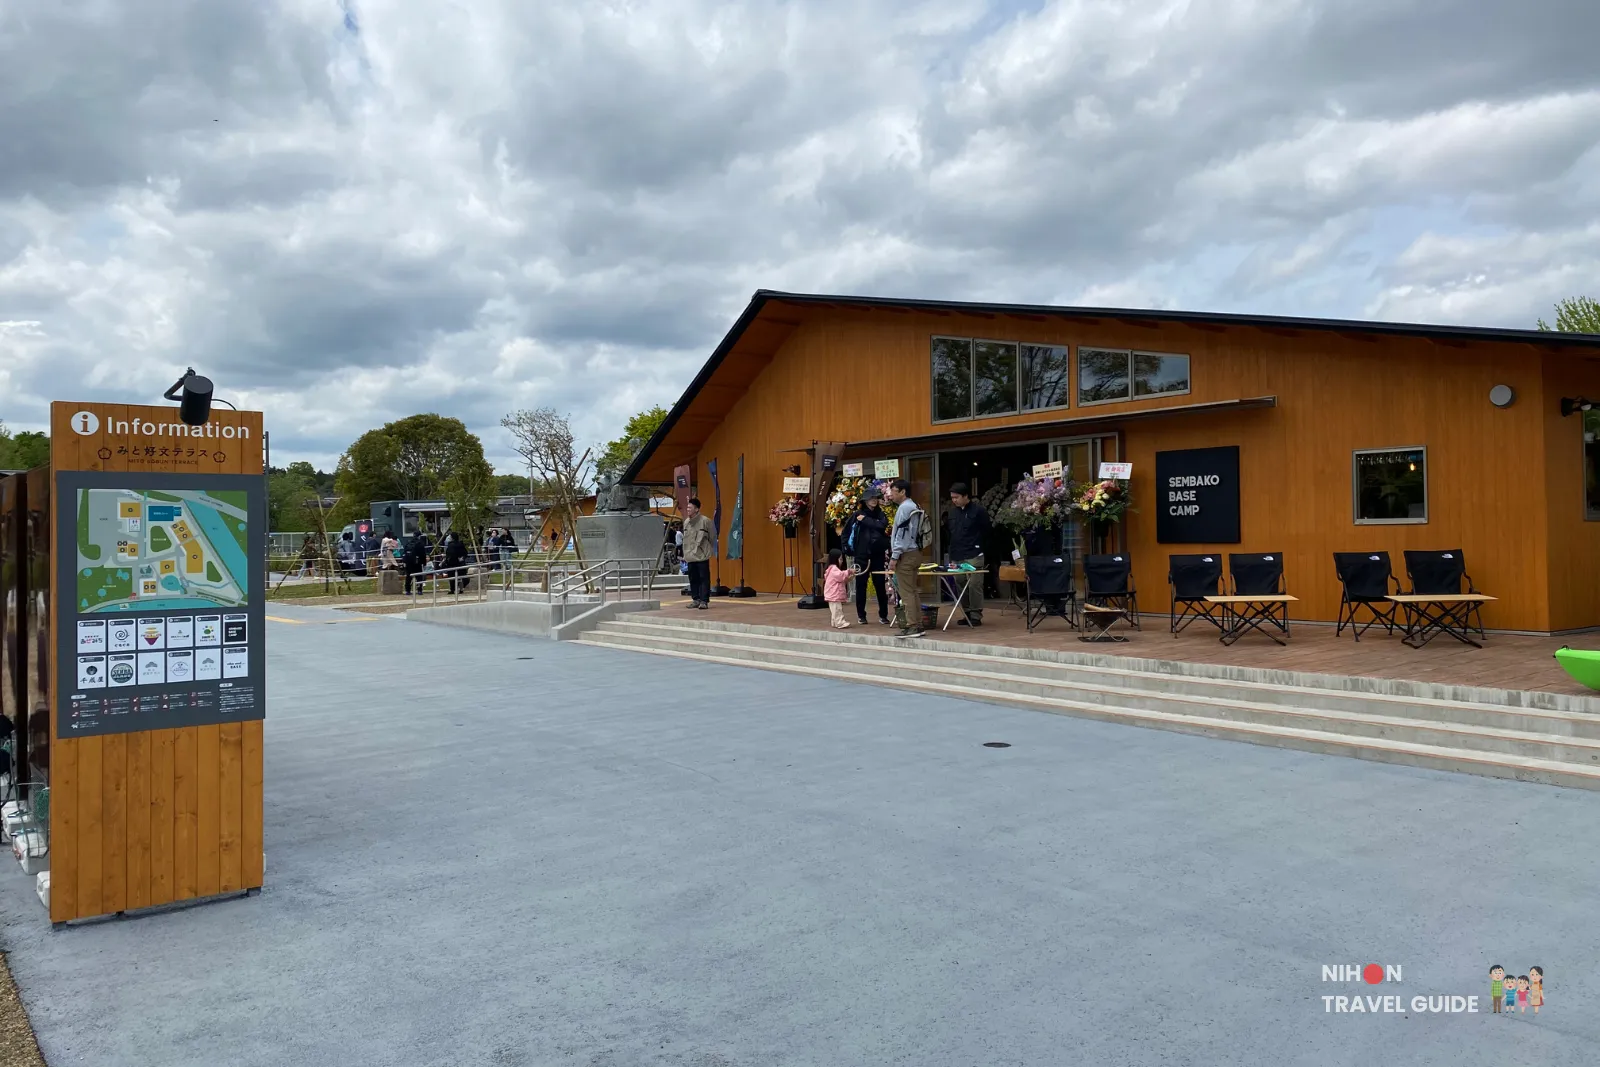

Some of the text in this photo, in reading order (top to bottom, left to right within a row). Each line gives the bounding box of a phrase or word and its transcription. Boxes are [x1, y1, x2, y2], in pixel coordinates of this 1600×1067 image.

[107, 416, 250, 439] Information
[117, 445, 208, 458] みと好文テラス
[1168, 474, 1220, 488] SEMBAKO
[1168, 490, 1197, 502] BASE
[1169, 504, 1200, 516] CAMP
